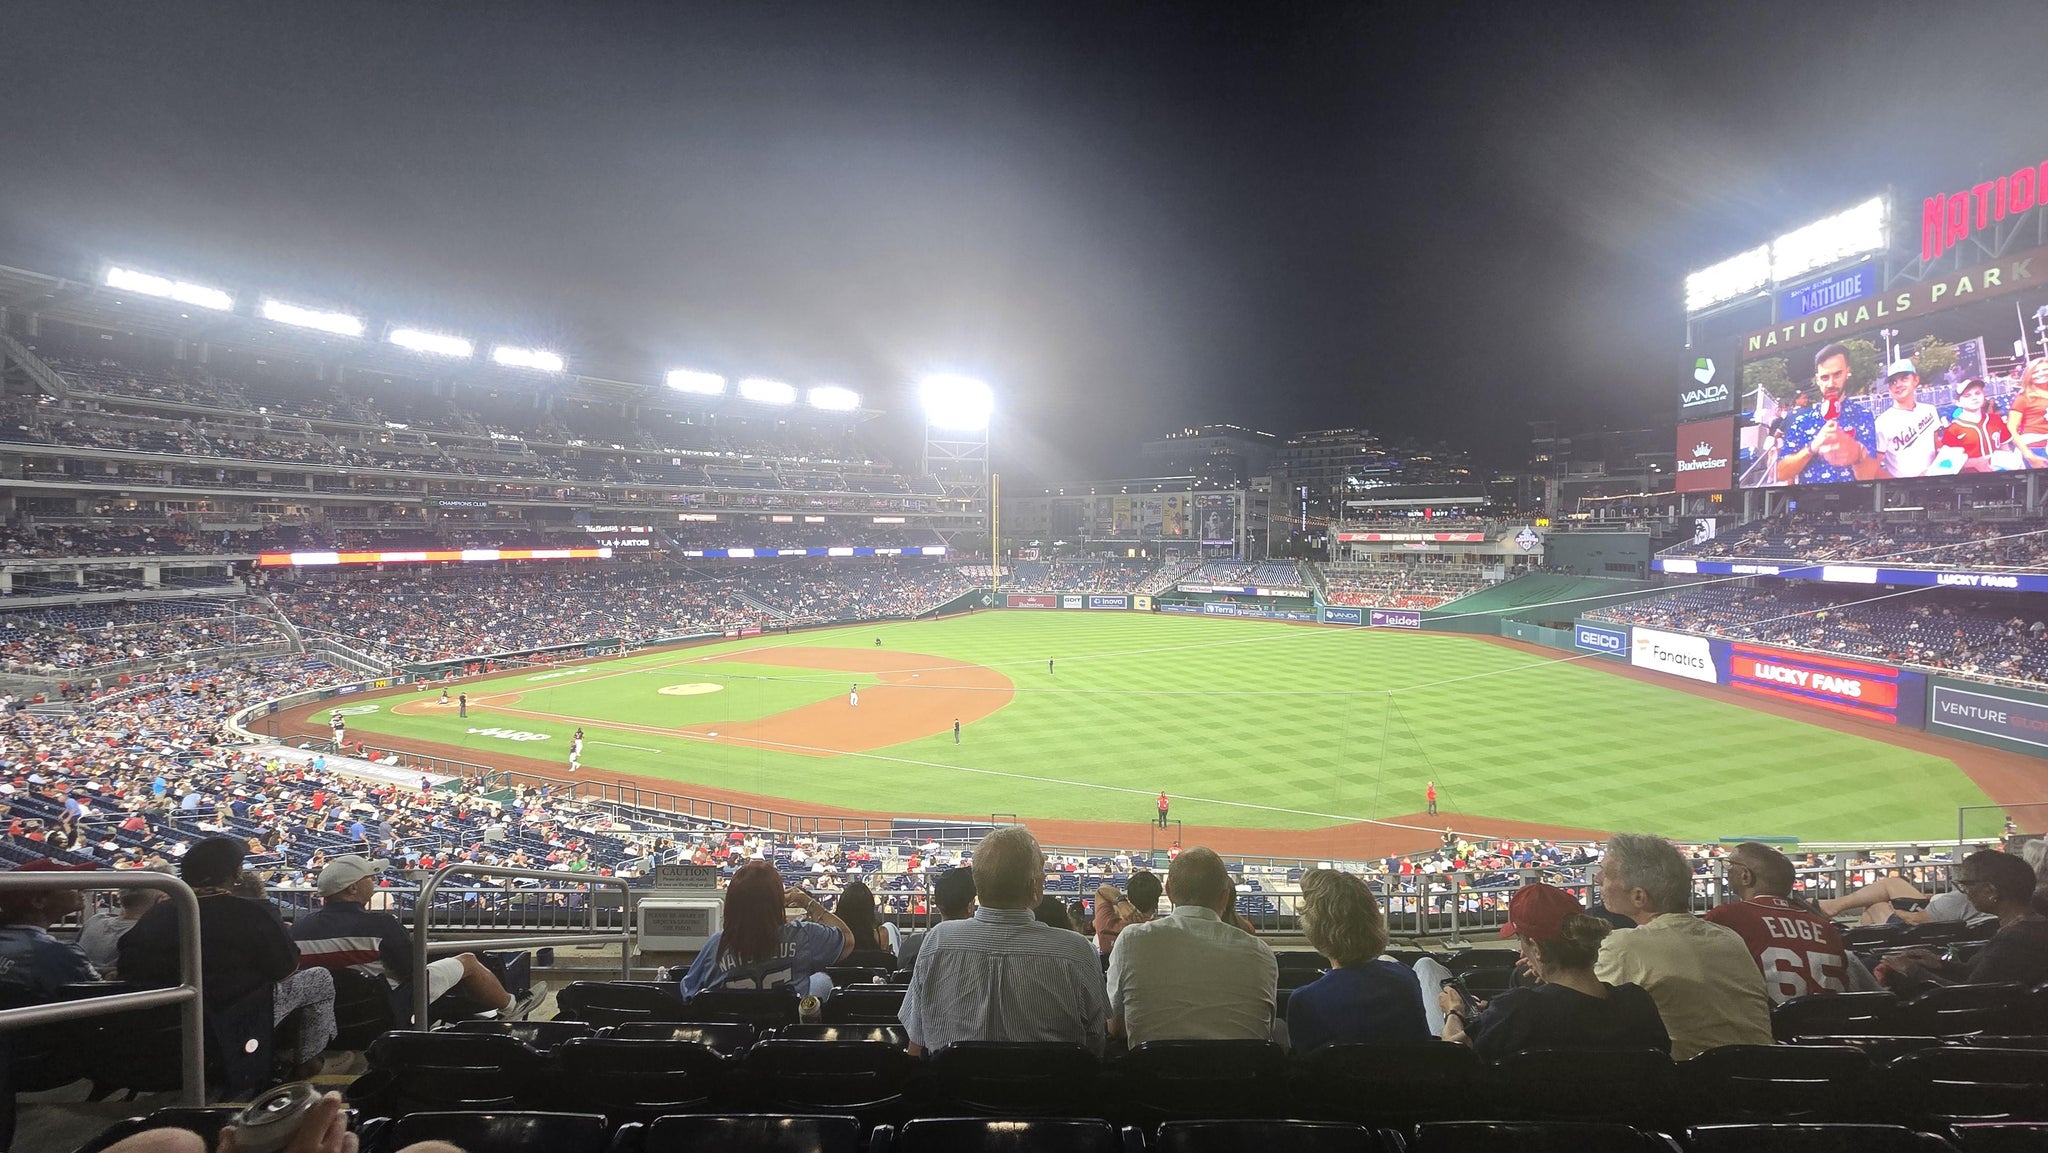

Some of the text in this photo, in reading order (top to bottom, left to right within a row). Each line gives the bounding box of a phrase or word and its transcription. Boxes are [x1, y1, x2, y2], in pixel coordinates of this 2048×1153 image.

[1749, 258, 2032, 351] NATIONALS PARK
[1802, 274, 1861, 312] NATITUDE
[1681, 384, 1728, 403] VANDA
[1678, 459, 1727, 472] Budweiser
[1937, 574, 2017, 588] LUCKY FANS
[1386, 615, 1417, 626] leidos
[1581, 632, 1619, 649] GEICO
[1654, 645, 1704, 669] Fanatics
[1755, 663, 1861, 697] LUCKY FANS
[1941, 701, 2007, 724] VENTURE
[662, 867, 709, 876] CAUTION
[1761, 916, 1827, 945] EDGE
[1760, 946, 1846, 1001] 65
